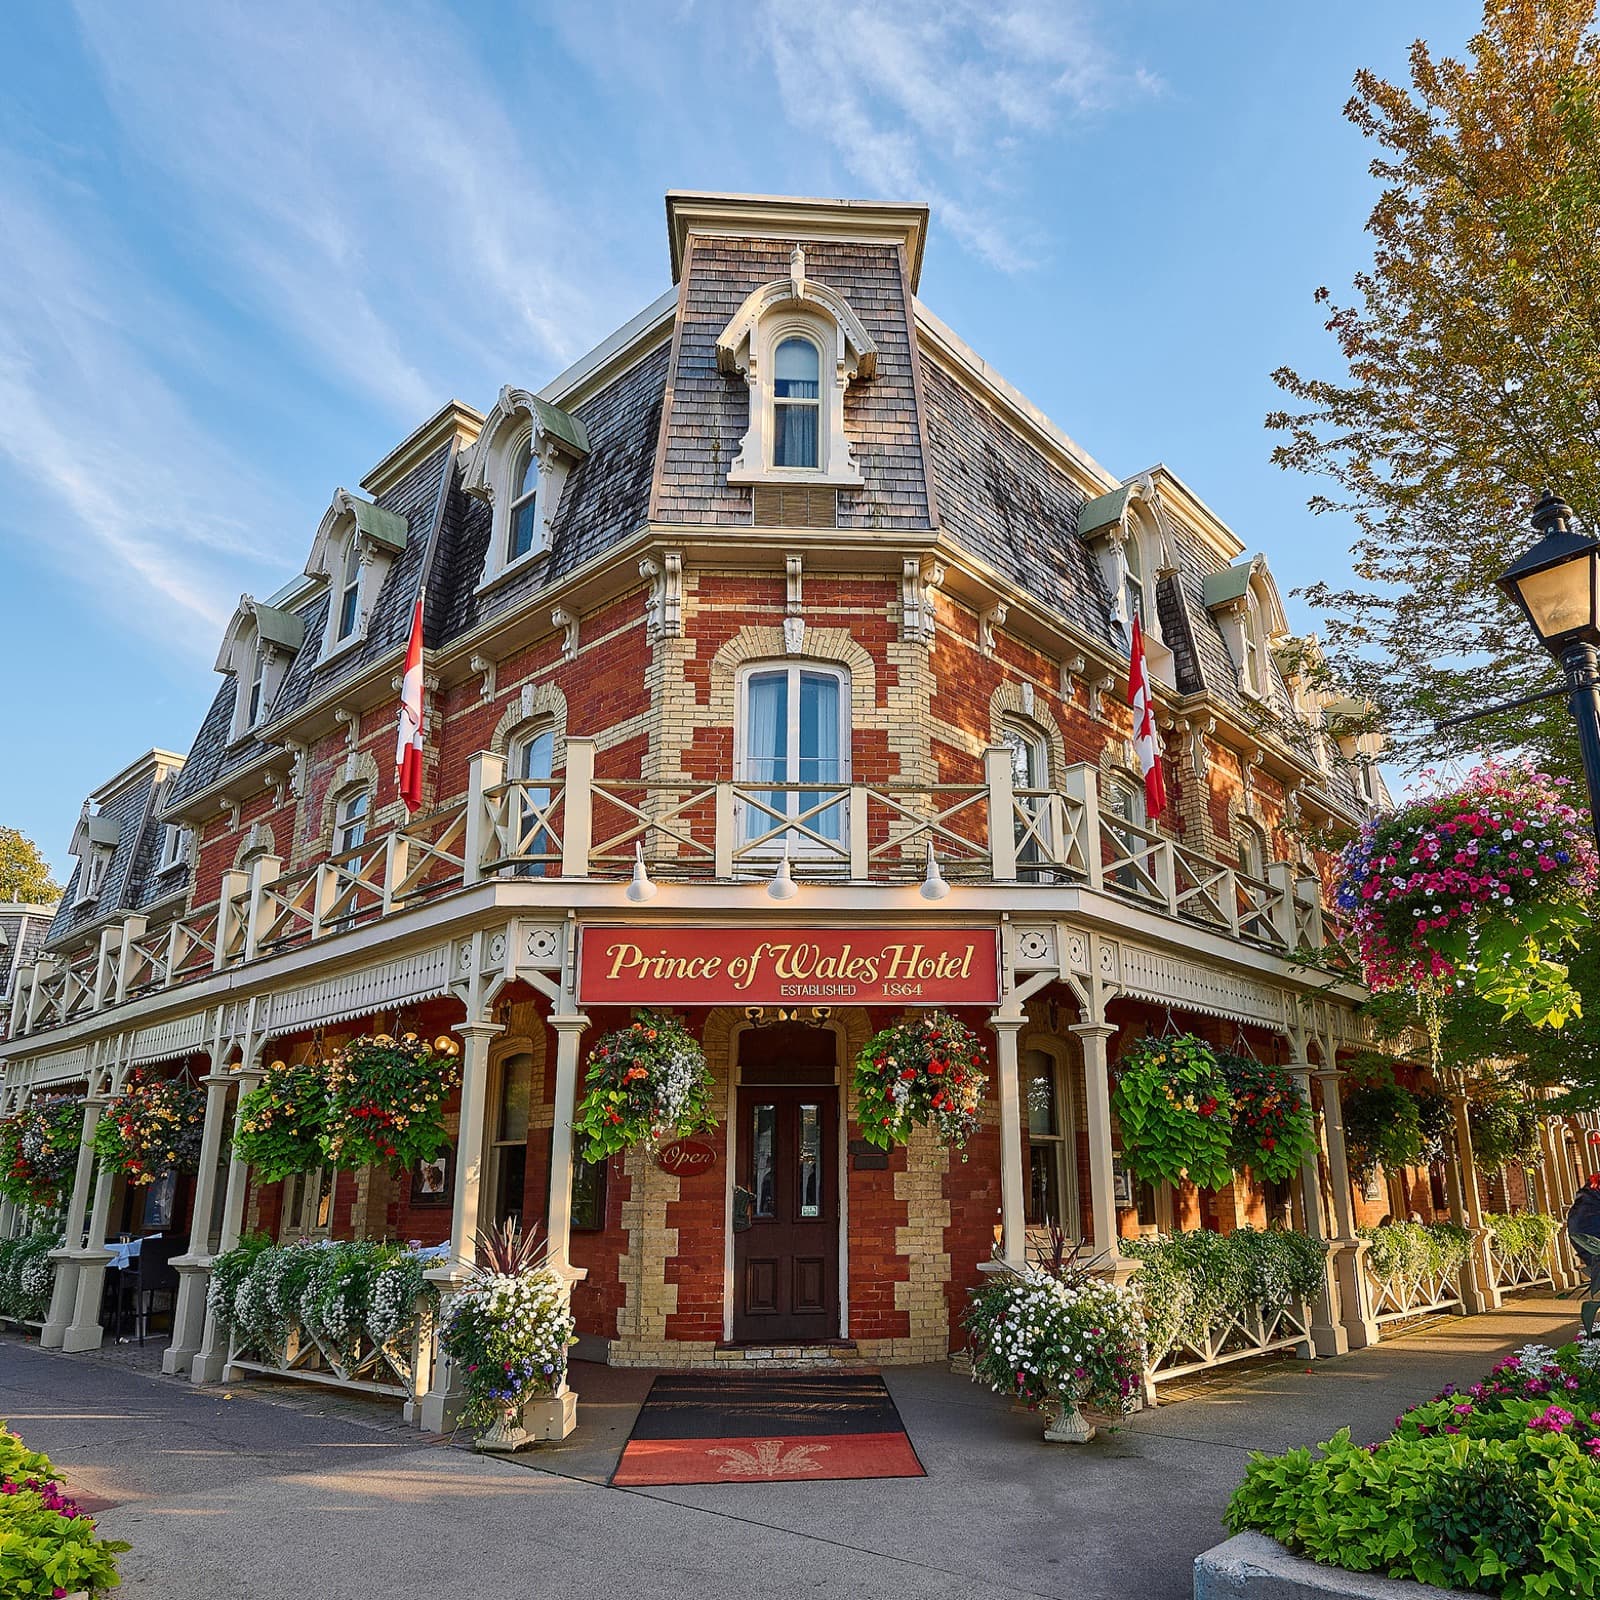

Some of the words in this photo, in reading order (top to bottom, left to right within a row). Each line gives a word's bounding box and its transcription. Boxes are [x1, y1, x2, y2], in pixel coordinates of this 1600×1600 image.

[606, 943, 722, 980] Prince
[727, 942, 771, 990] of
[768, 943, 880, 984] Wales
[880, 944, 975, 980] Hotel
[780, 984, 857, 997] ESTABLISHED
[881, 982, 923, 997] 1864
[663, 1145, 711, 1171] Open
